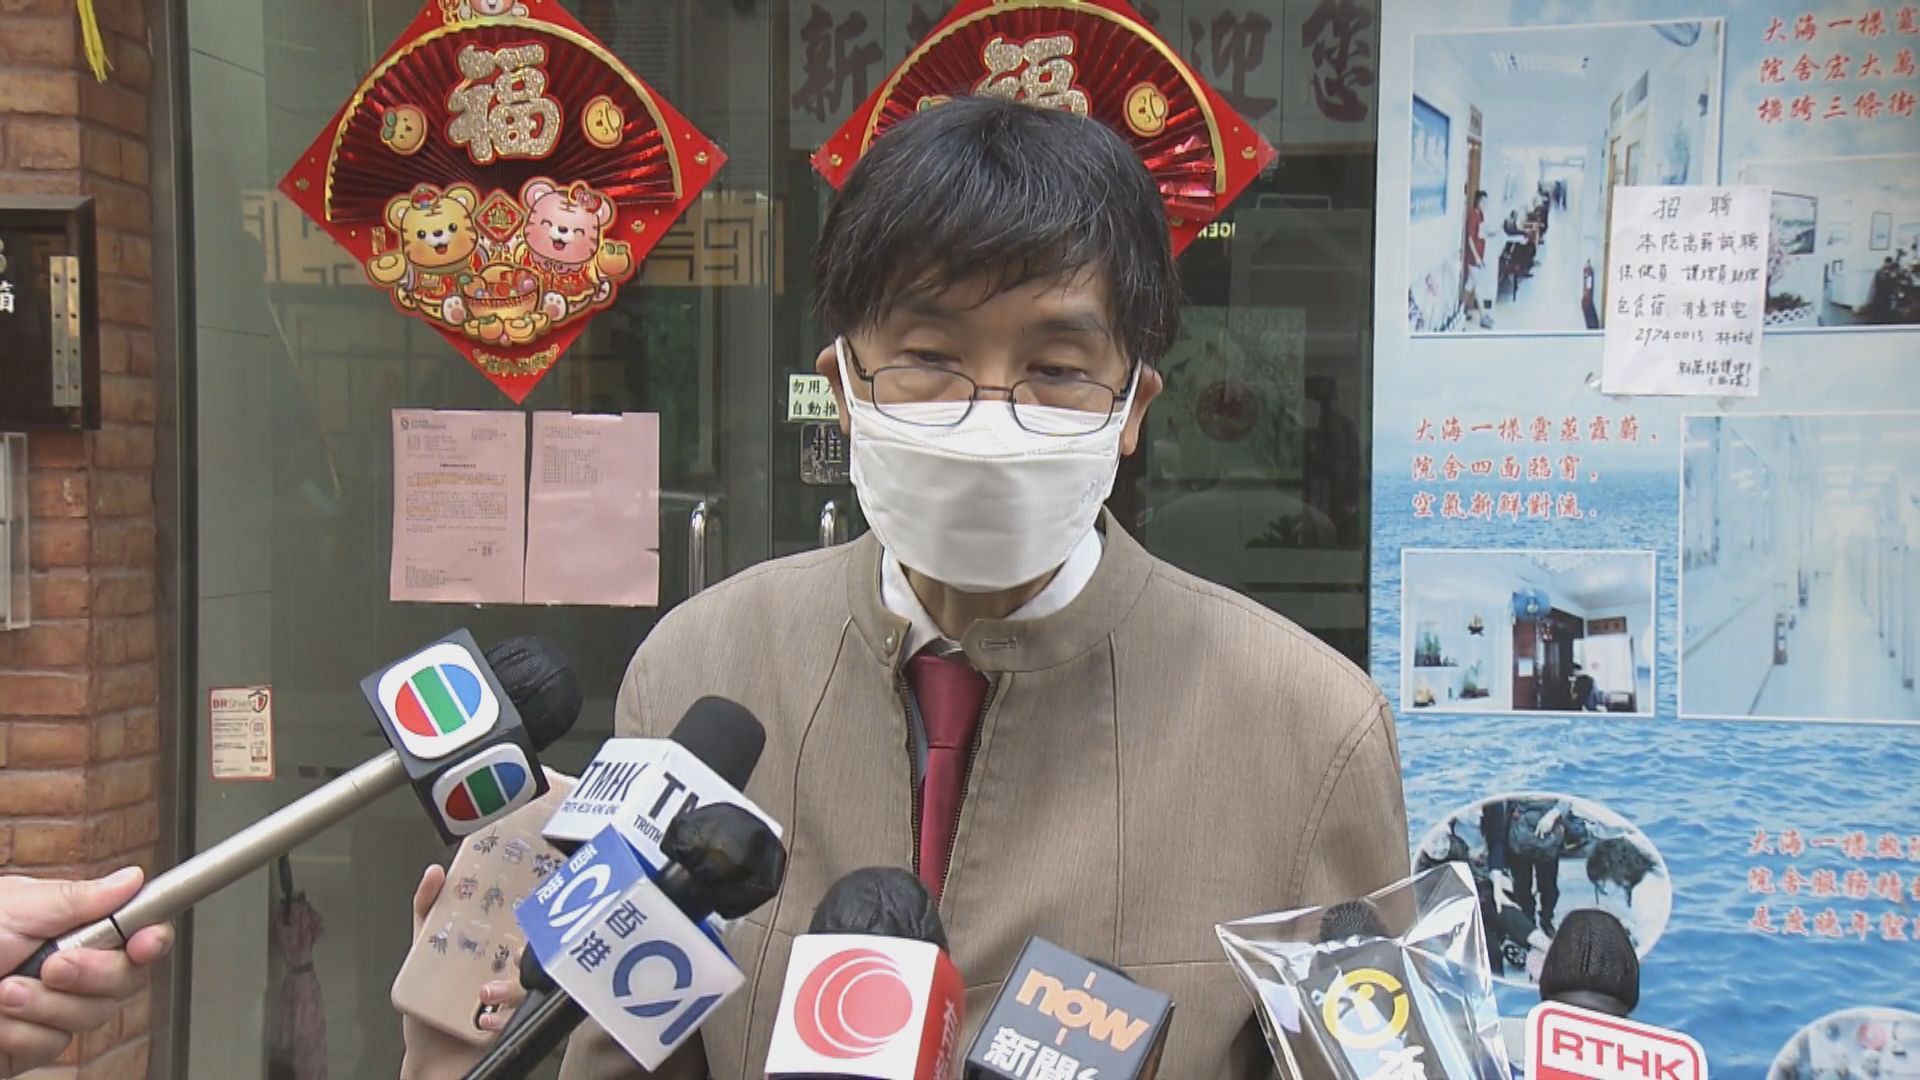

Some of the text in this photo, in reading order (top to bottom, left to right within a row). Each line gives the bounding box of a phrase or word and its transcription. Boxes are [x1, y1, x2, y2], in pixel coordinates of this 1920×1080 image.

[447, 43, 561, 162] 福
[573, 760, 650, 802] TMHK
[632, 814, 664, 845] TRUTH
[568, 898, 649, 974] 香港
[1015, 967, 1151, 1052] now
[982, 1025, 1100, 1080] 新聞
[1552, 1027, 1686, 1080] RTHK
